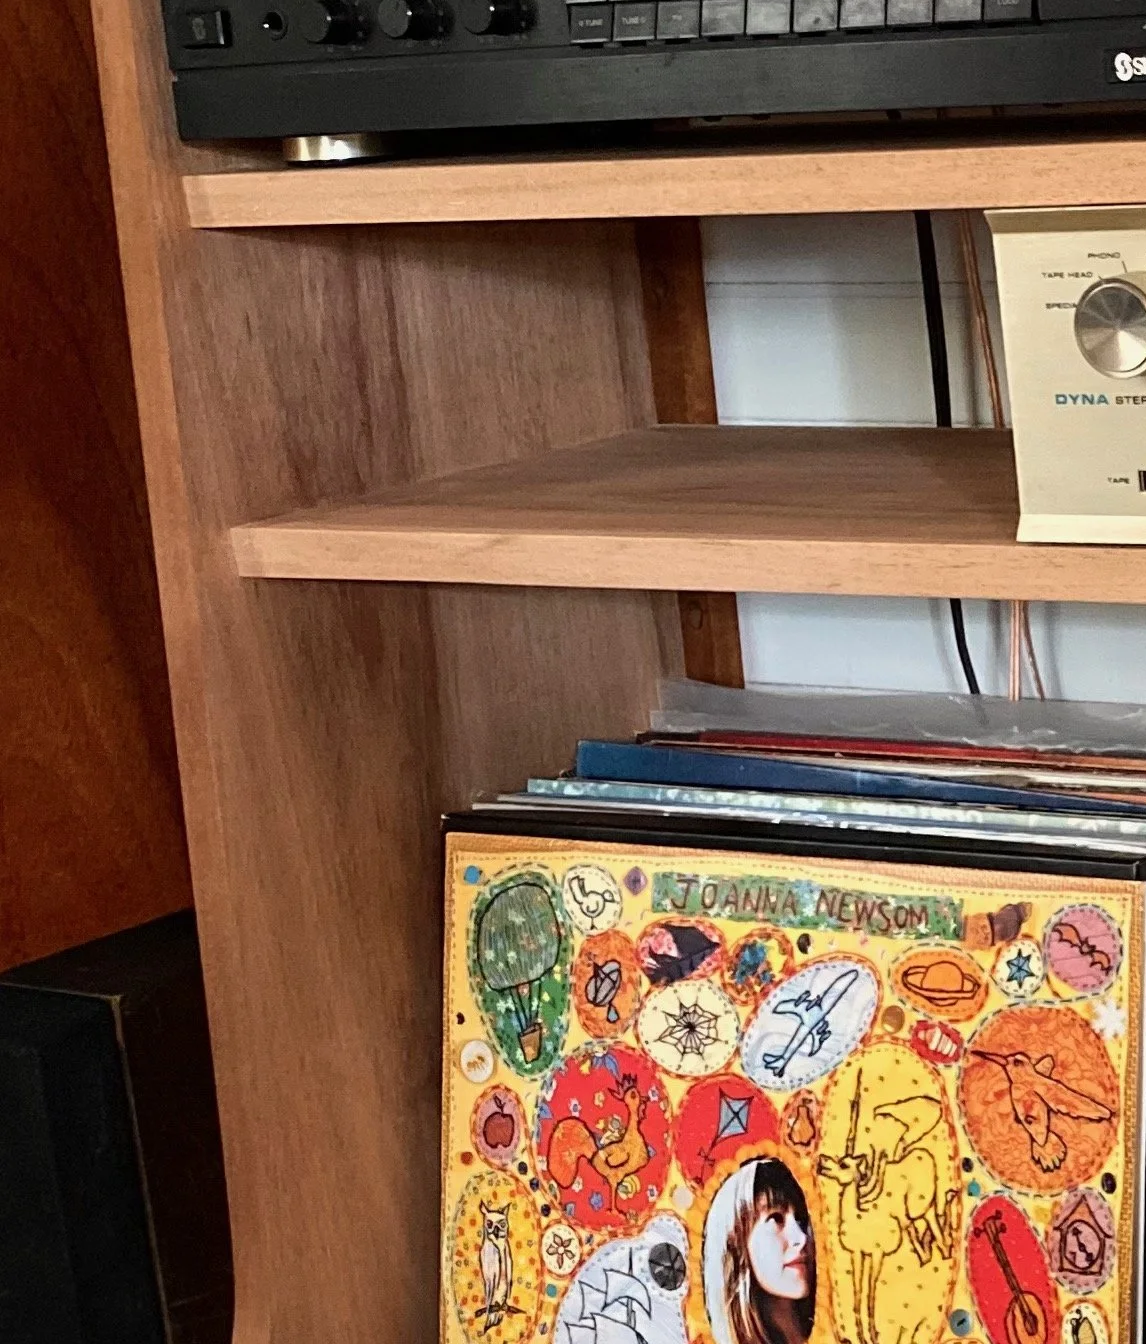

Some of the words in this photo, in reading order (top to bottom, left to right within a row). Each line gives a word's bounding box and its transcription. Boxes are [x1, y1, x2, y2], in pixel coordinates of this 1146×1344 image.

[1087, 251, 1121, 260] PHONO
[1041, 271, 1065, 279] TAPE
[1067, 270, 1094, 278] HEAD
[1055, 393, 1110, 406] DYNA
[1107, 477, 1130, 485] TAPE
[670, 877, 799, 917] JOANNA
[814, 887, 931, 934] NEWSOM
